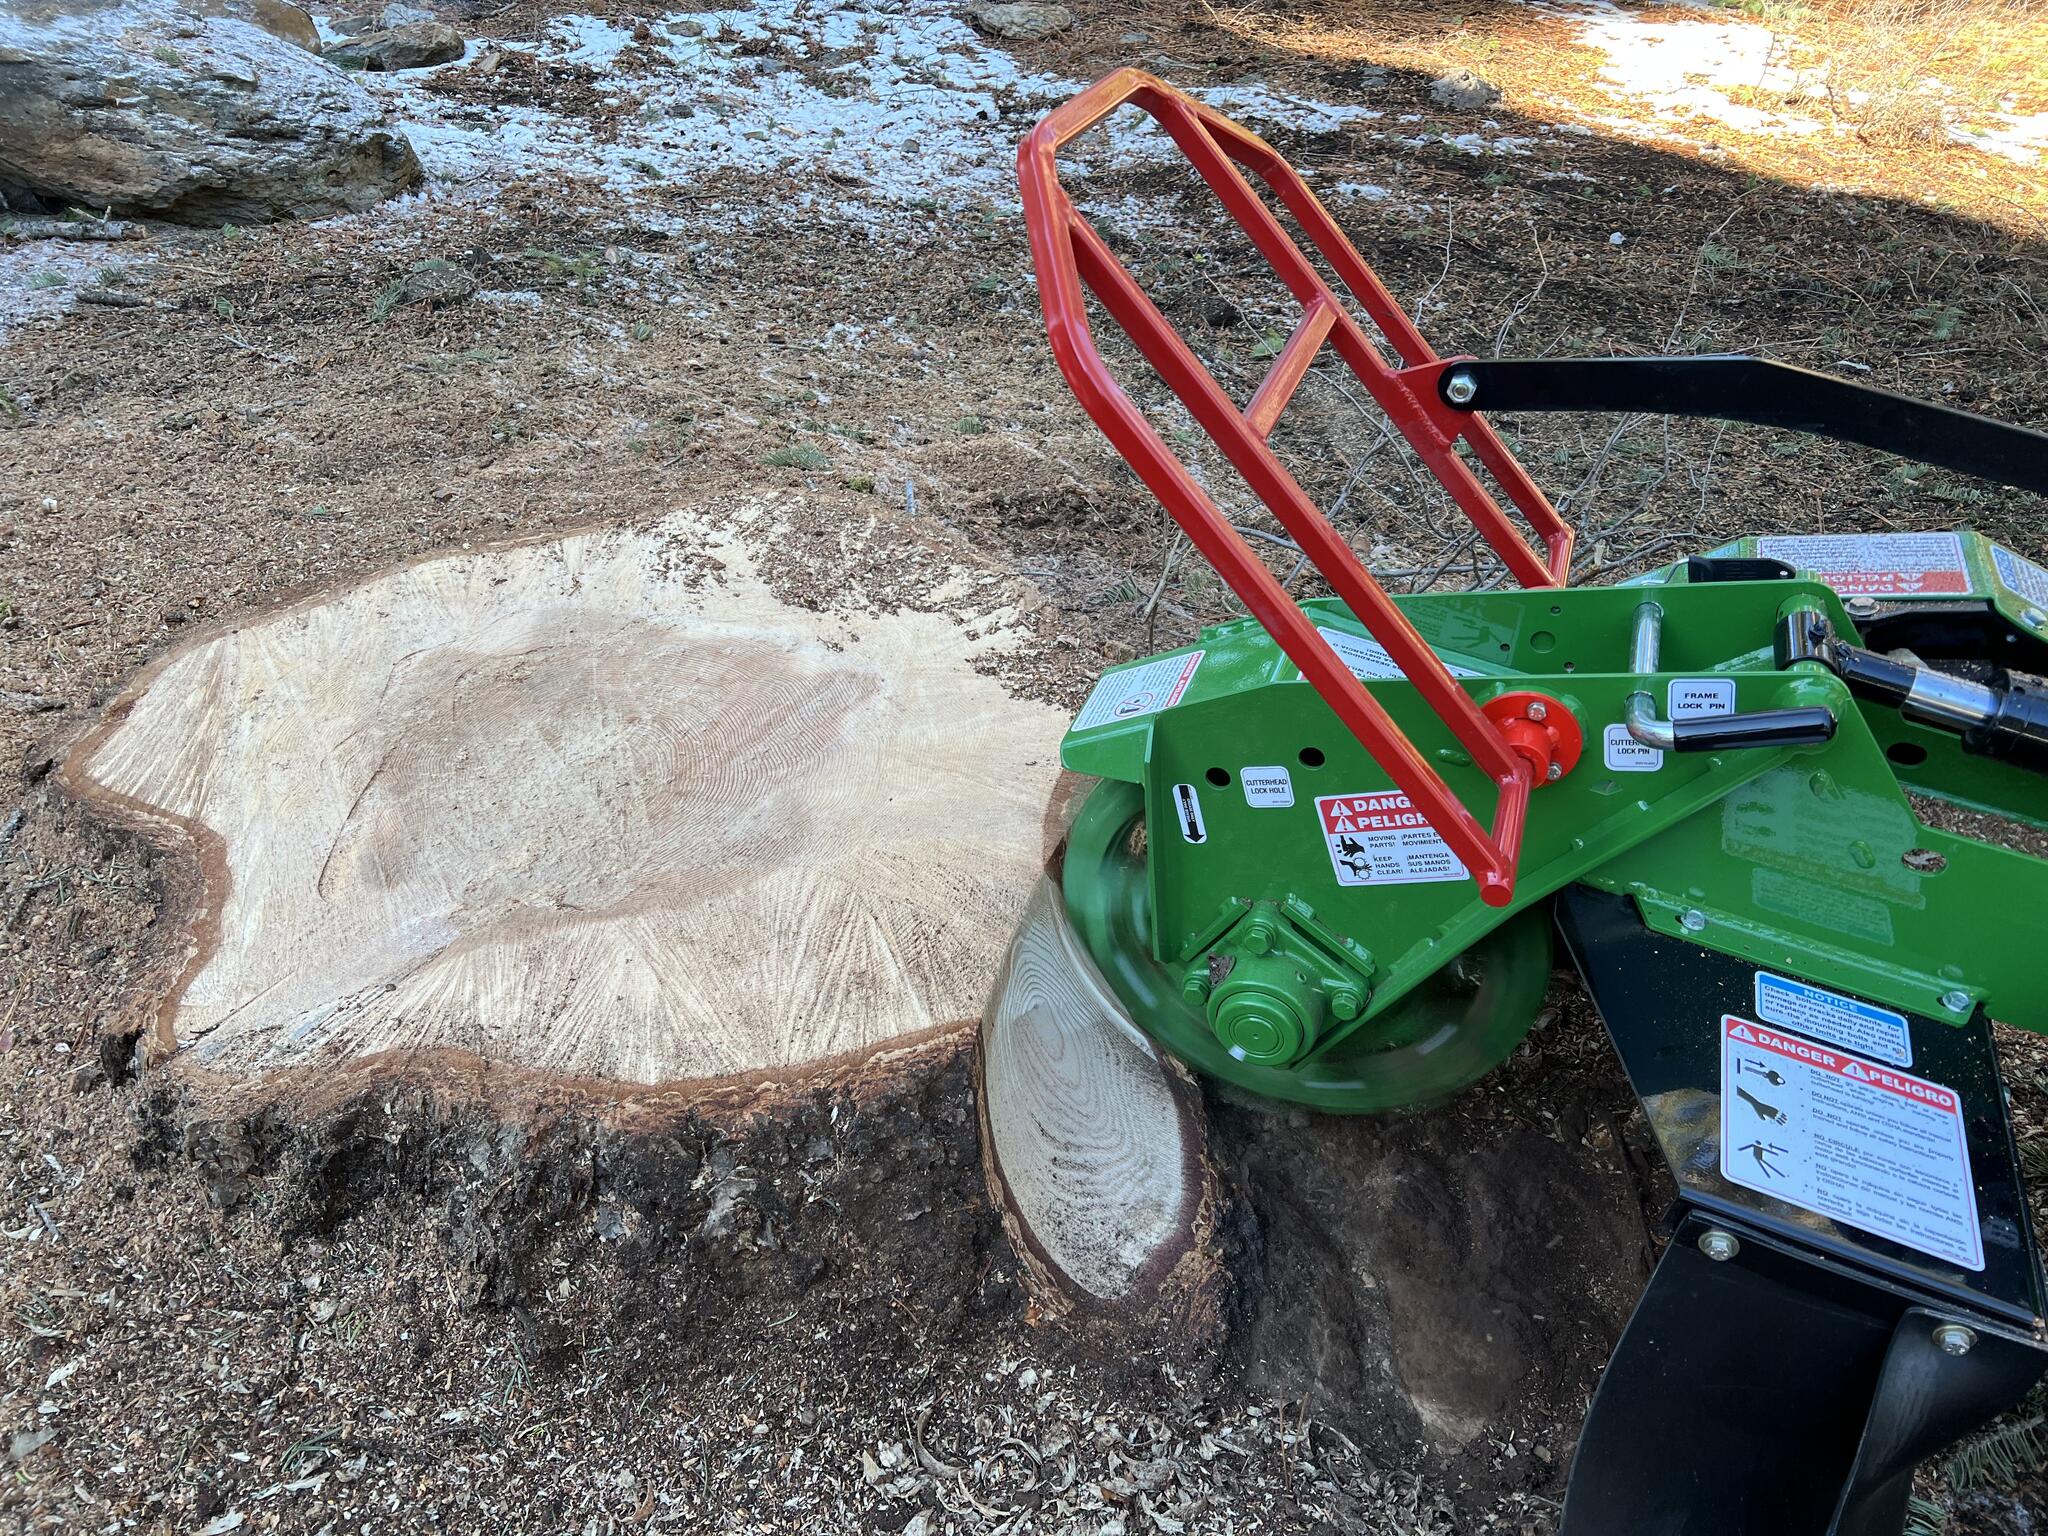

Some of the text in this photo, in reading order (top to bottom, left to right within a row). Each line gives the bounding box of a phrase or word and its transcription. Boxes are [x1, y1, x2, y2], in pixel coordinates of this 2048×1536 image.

[1833, 584, 1894, 593] DANG
[1677, 702, 1726, 710] LOCK PIN
[1246, 778, 1288, 786] CUTTERHEAD
[1353, 796, 1411, 812] DANG
[1402, 839, 1443, 847] MOVIMIENT
[1410, 866, 1450, 874] ALEJADAS!
[1803, 988, 1858, 1012] NOTICE
[1758, 1032, 1953, 1108] DANGER PELIGRO
